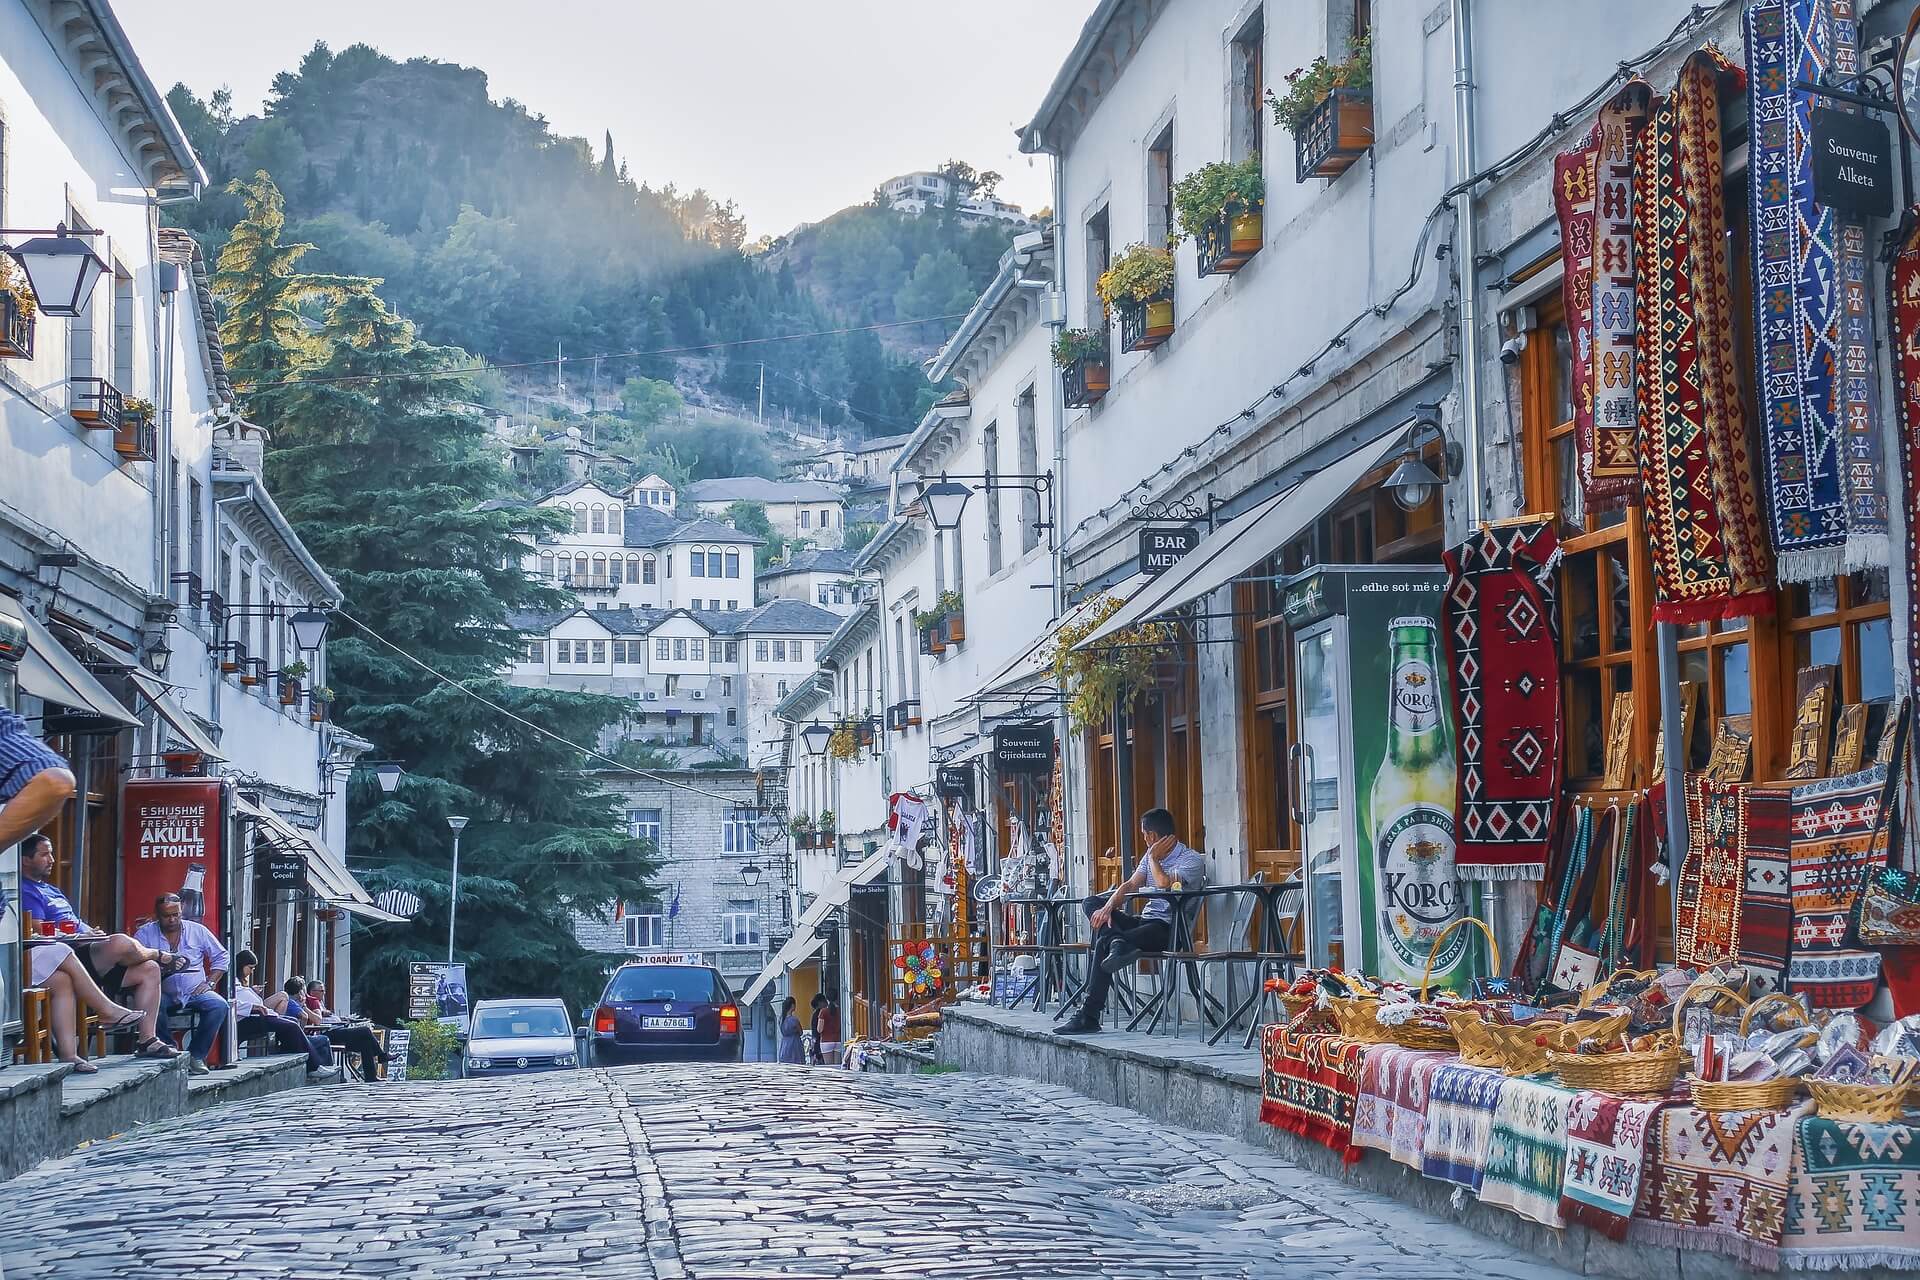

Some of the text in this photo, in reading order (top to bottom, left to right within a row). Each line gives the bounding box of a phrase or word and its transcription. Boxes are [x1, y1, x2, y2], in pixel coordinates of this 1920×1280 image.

[1828, 138, 1878, 164] Souvenir
[1837, 165, 1874, 187] Alketa
[1154, 535, 1187, 549] BAR
[1147, 553, 1186, 567] MEN
[1392, 582, 1410, 592] sot
[1413, 582, 1430, 592] më
[1433, 584, 1440, 592] e
[1002, 738, 1041, 747] Souvenir
[999, 750, 1047, 761] Gjirokastra
[141, 807, 147, 816] E
[140, 819, 205, 828] FRESKUESE
[140, 827, 205, 843] AKULL
[140, 841, 205, 858] E FTOHTË
[270, 862, 299, 870] Bar-Kafe
[377, 889, 421, 916] ANTIQUE
[650, 955, 684, 964] QARKUT
[650, 1018, 660, 1027] AA
